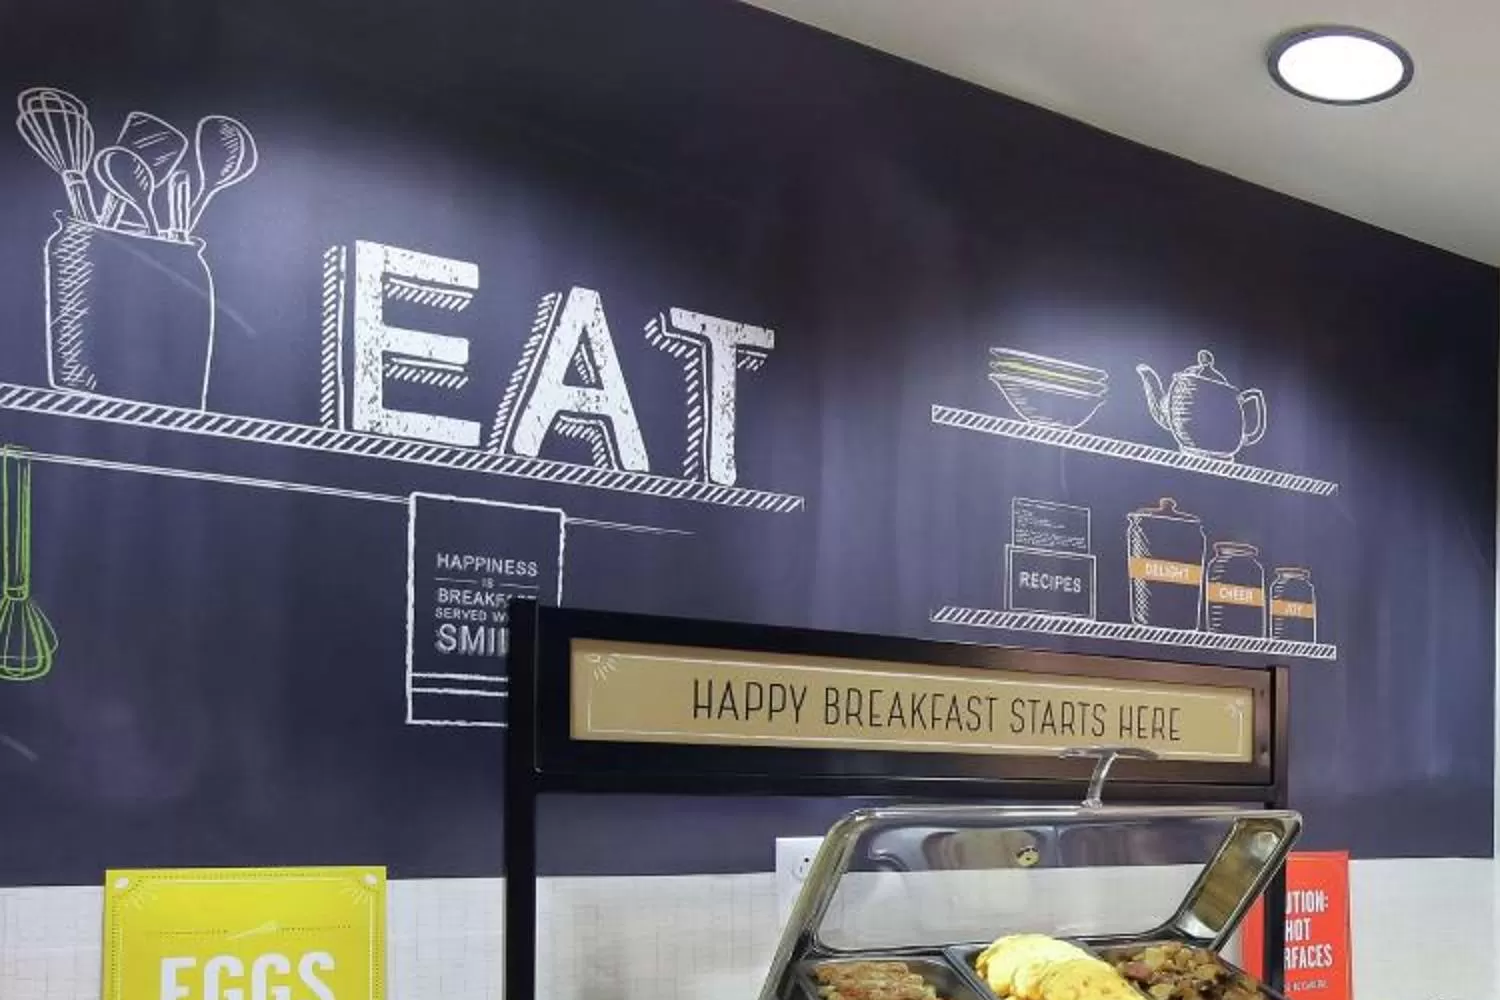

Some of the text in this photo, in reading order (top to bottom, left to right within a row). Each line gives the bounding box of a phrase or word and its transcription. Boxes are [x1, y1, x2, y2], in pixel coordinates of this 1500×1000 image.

[322, 240, 774, 486] EAT
[436, 553, 539, 577] HAPPINESS
[1145, 562, 1190, 580] DELIGHT
[481, 578, 495, 589] IS
[1019, 571, 1082, 593] RECIPES
[437, 588, 537, 608] BREAKF
[1219, 587, 1253, 601] CHEER
[435, 607, 487, 621] SERVED
[692, 678, 1182, 742] HAPPY BREAKFAST STARTS HERE
[1285, 890, 1329, 913] UTION:
[1285, 917, 1311, 941] HOT
[1284, 944, 1333, 971] RFACES
